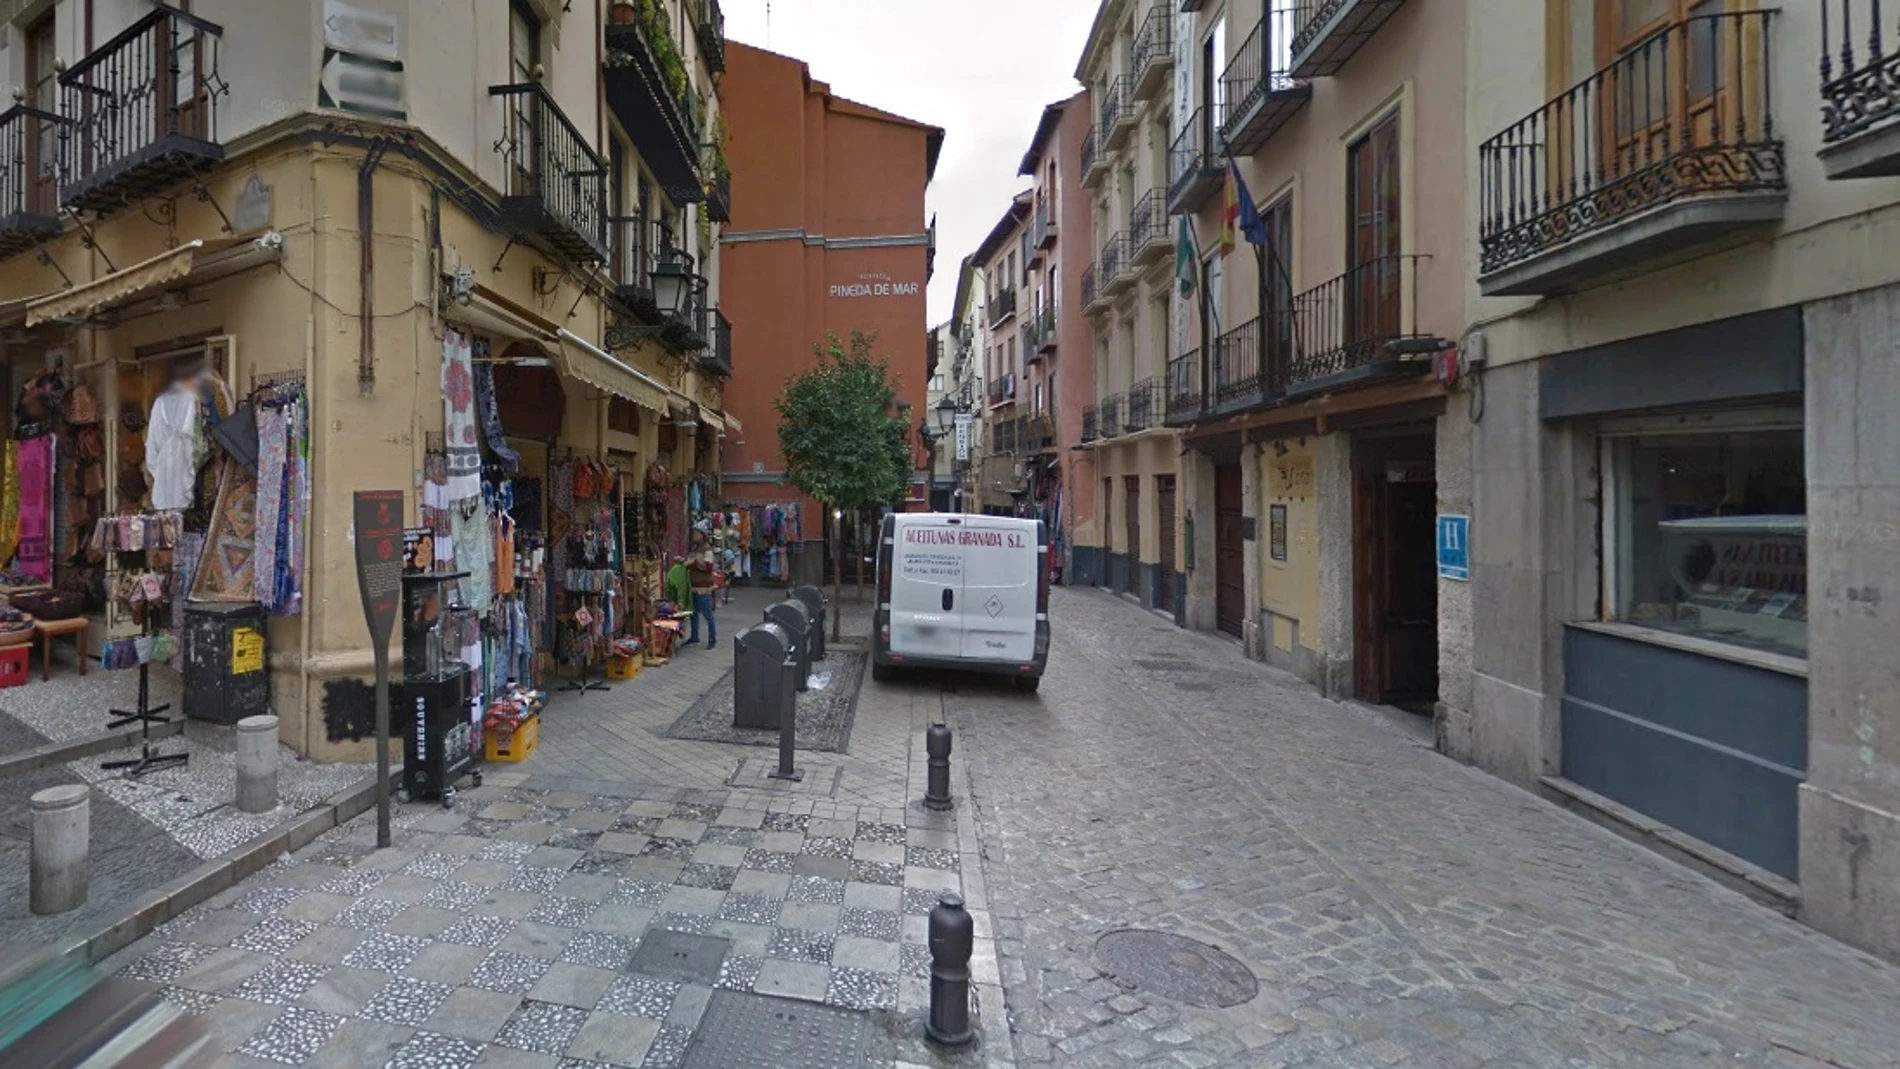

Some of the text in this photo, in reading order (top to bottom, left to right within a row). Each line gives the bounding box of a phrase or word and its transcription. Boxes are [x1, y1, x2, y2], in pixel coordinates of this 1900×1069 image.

[829, 282, 918, 297] PINEDA DE MAR
[906, 529, 955, 545] ACEITUNAS
[958, 531, 1002, 547] GRANADA
[1445, 521, 1459, 550] H
